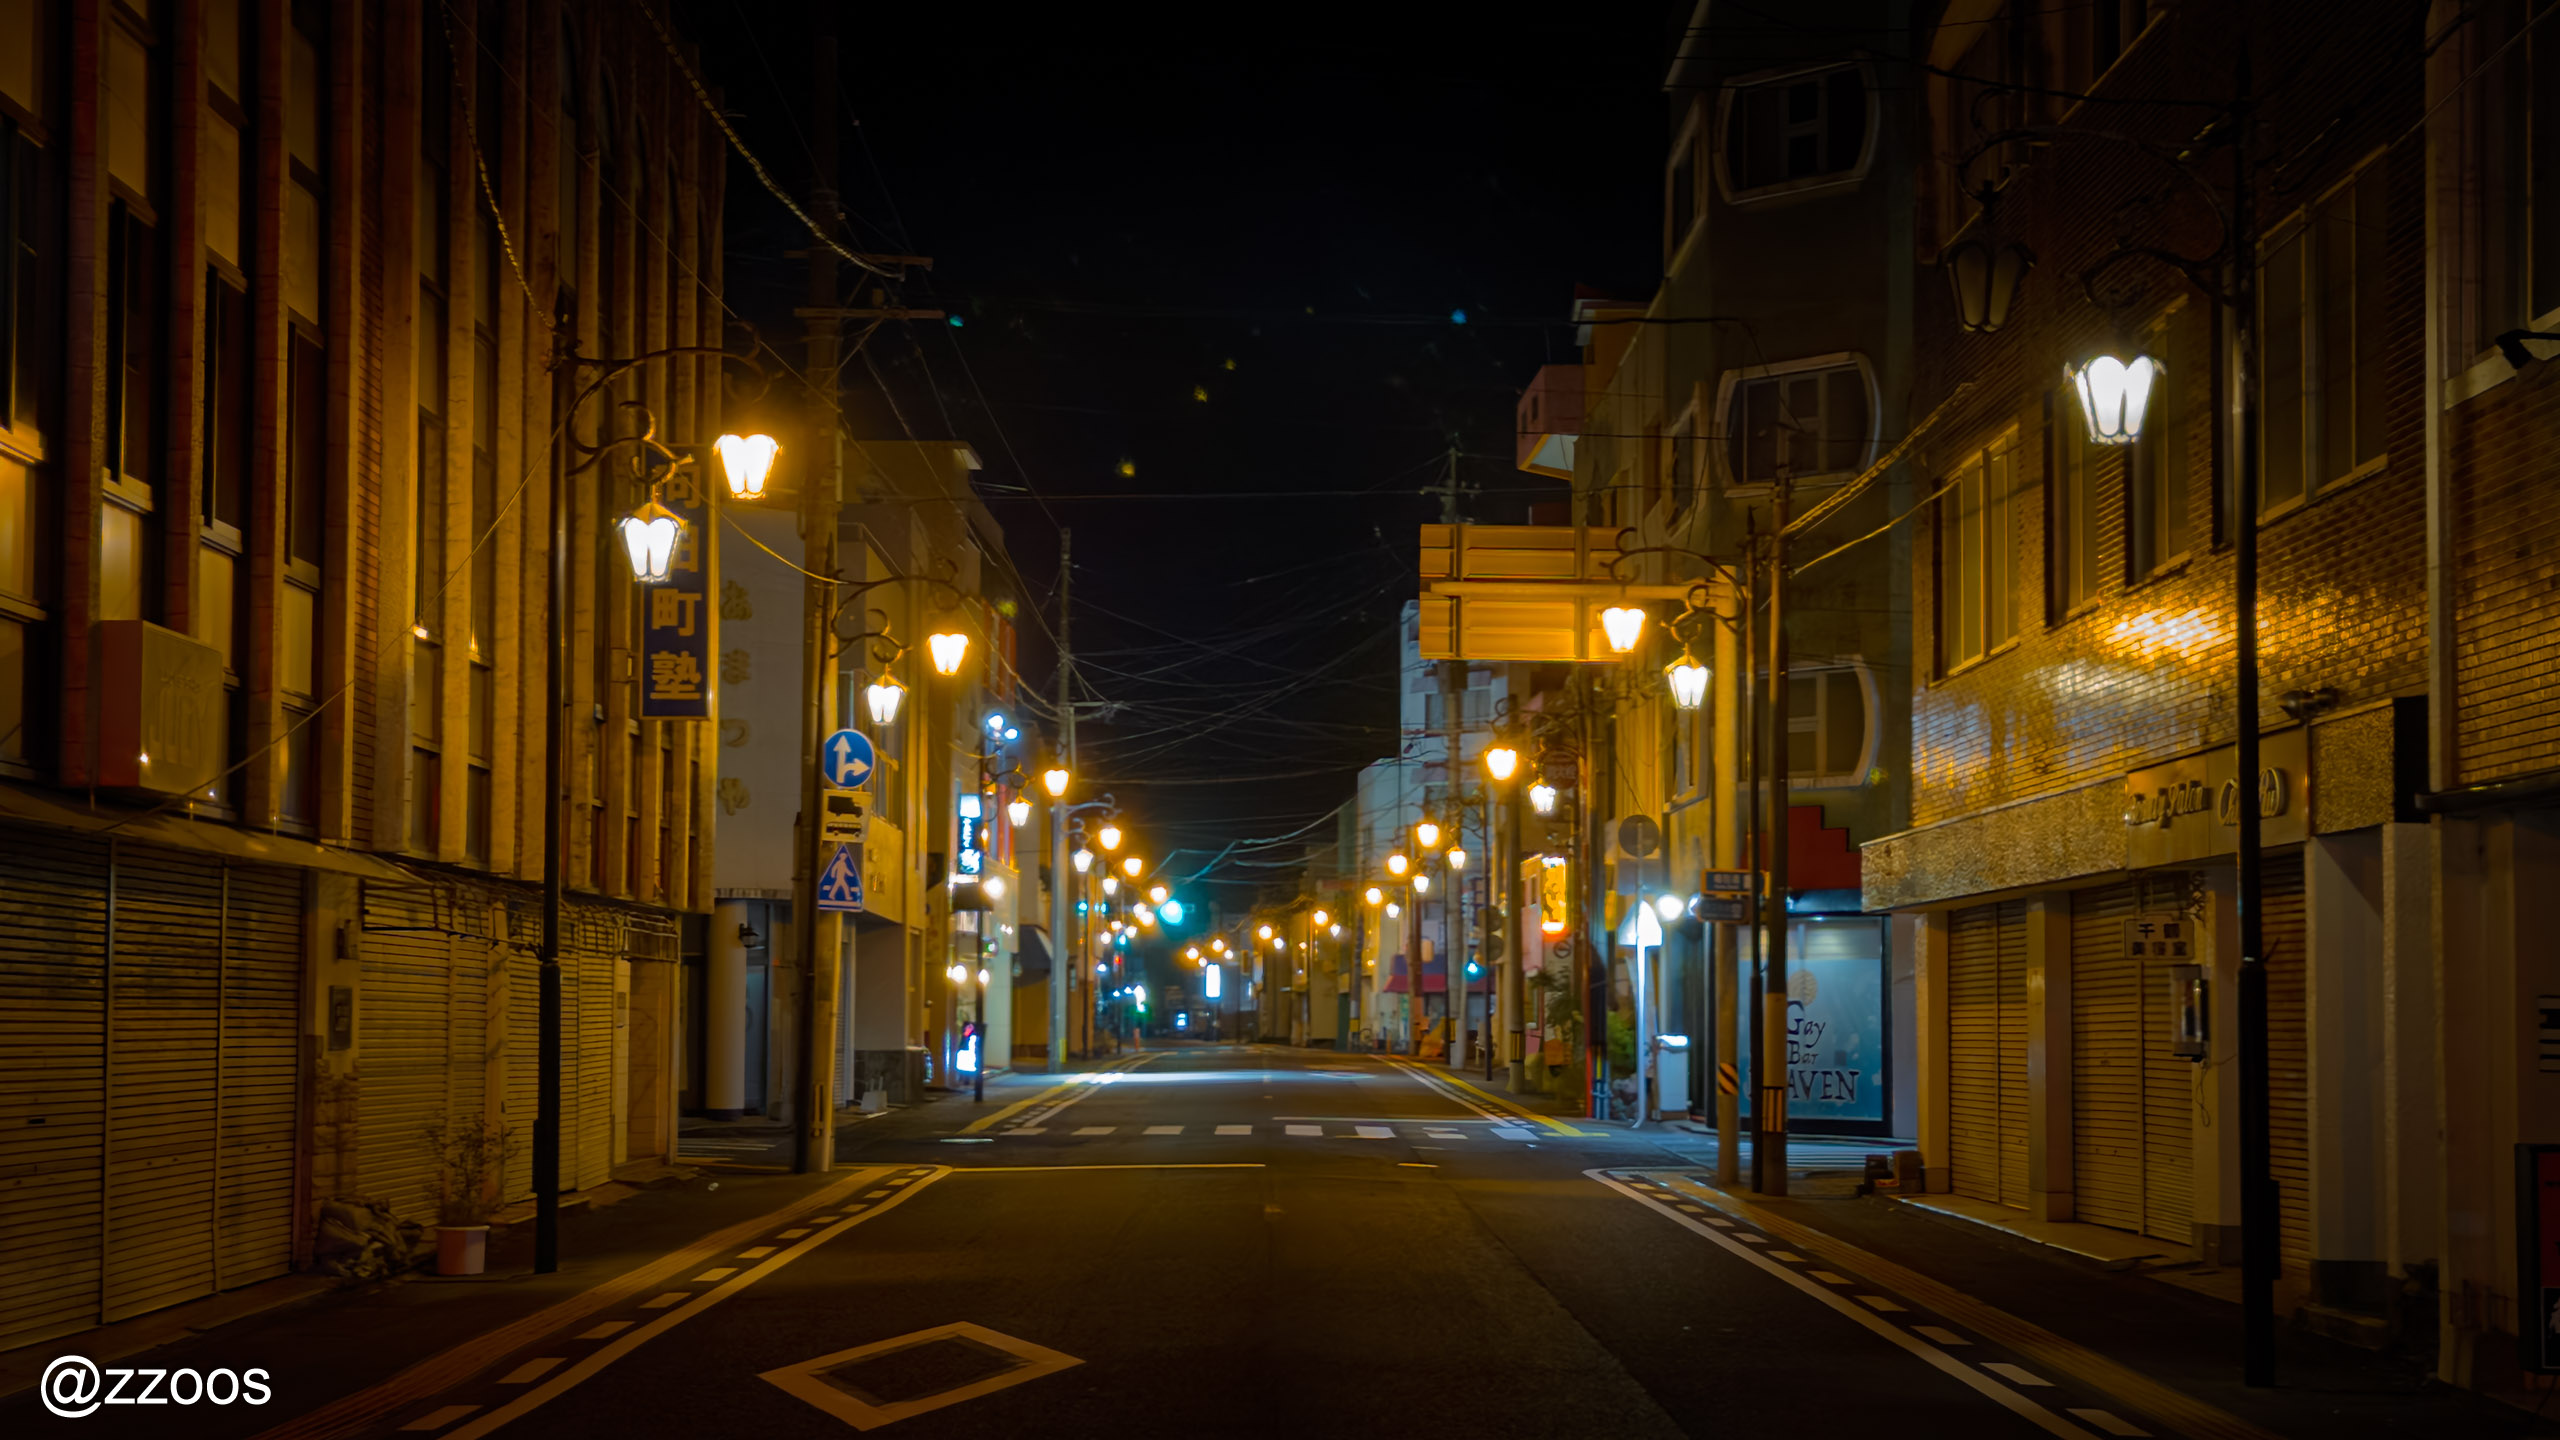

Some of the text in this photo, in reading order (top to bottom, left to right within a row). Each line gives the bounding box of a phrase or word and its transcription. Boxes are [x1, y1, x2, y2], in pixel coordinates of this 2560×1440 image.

[1786, 1000, 1826, 1048] Gay
[1786, 1040, 1818, 1064] Bar
[1750, 1069, 1859, 1101] AVEN
